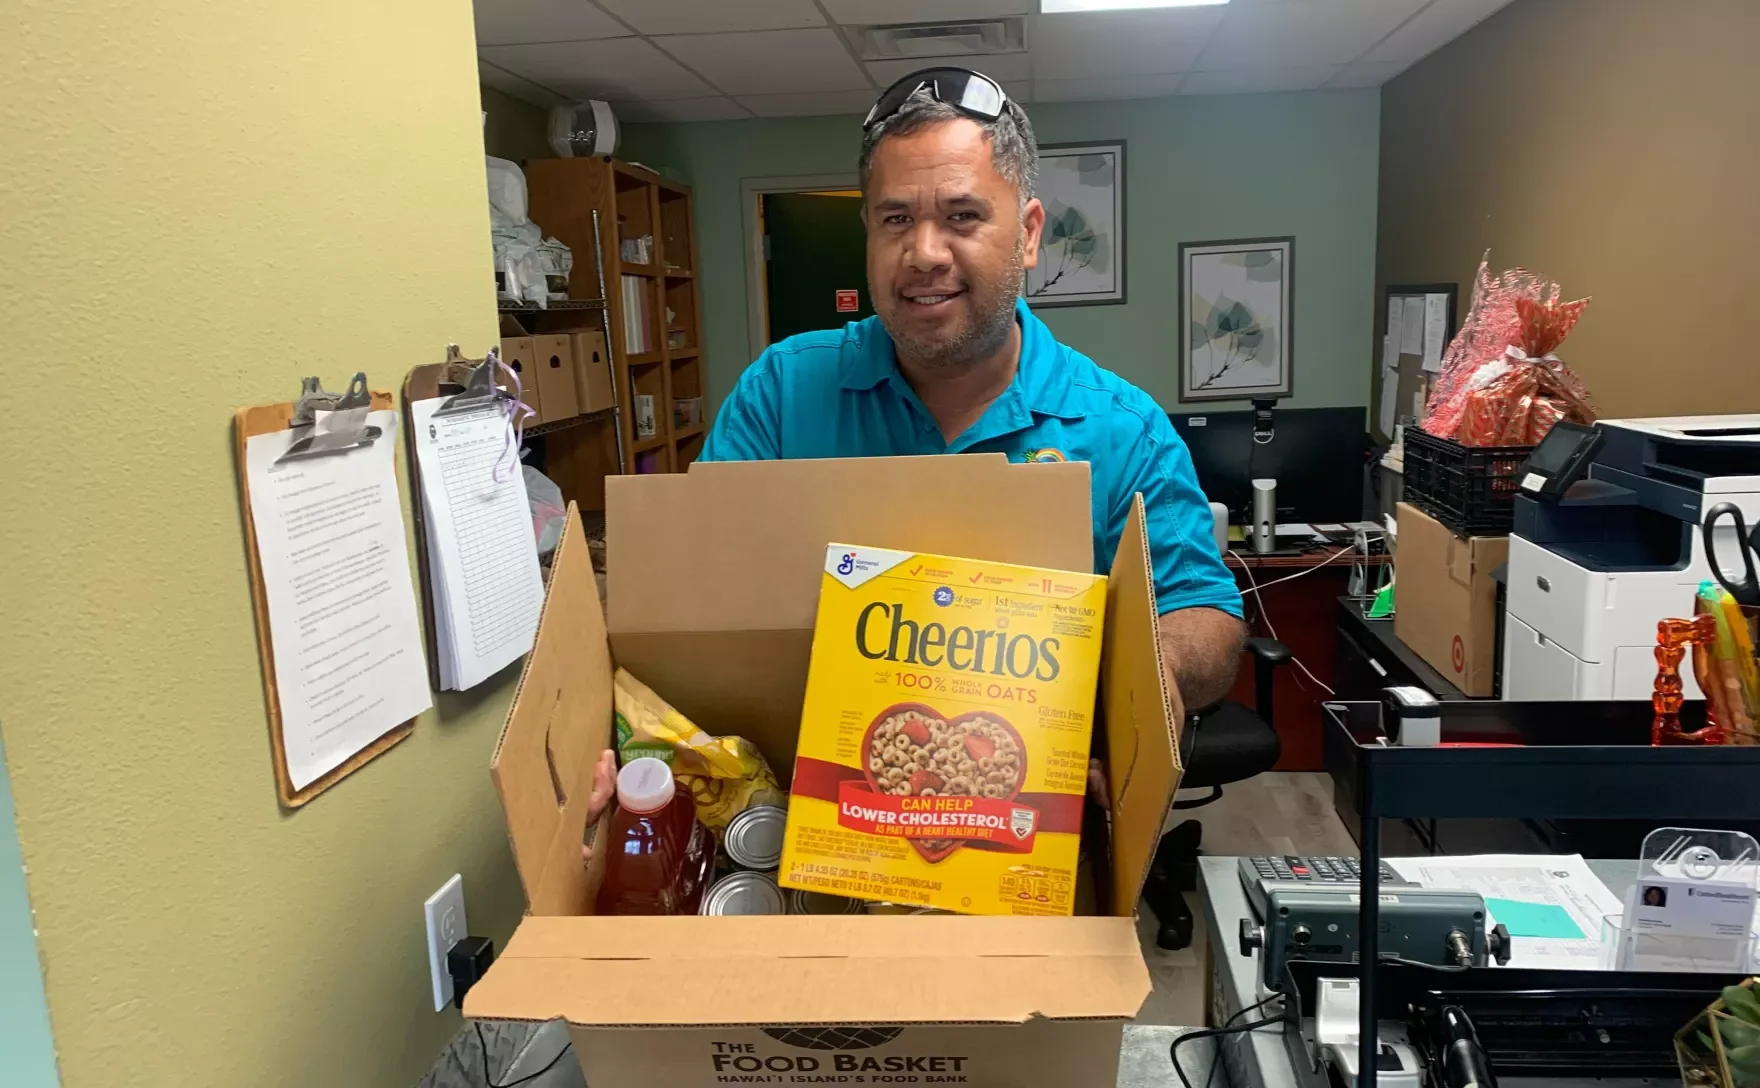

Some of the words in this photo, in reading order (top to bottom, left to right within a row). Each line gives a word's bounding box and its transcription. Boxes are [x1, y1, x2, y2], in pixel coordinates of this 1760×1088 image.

[856, 559, 879, 567] General
[855, 601, 1061, 682] Cheerios
[895, 672, 947, 692] 100%
[952, 679, 983, 689] WHOLE
[951, 686, 982, 697] GRAIN
[986, 684, 1037, 703] OATS
[1038, 705, 1066, 719] Gluten
[1068, 709, 1085, 721] Free
[901, 798, 932, 811] CAN
[935, 799, 973, 811] HELP
[842, 801, 897, 825] LOWER
[898, 812, 1007, 830] CHOLESTEROL
[875, 825, 885, 833] AS
[886, 825, 904, 834] PART
[905, 826, 914, 835] OF
[915, 826, 921, 835] A
[923, 826, 946, 836] HEART
[947, 826, 976, 837] HEALTHY
[977, 828, 994, 838] DIET
[805, 864, 814, 873] LB
[829, 867, 838, 876] OZ
[789, 873, 802, 883] NET
[831, 878, 847, 890] NETO
[853, 882, 862, 892] LB
[873, 884, 882, 895] OZ
[711, 1042, 755, 1053] THE
[711, 1054, 820, 1073] FOOD
[832, 1054, 968, 1073] BASKET
[872, 1075, 918, 1083] FOOD
[925, 1075, 968, 1083] BANK
